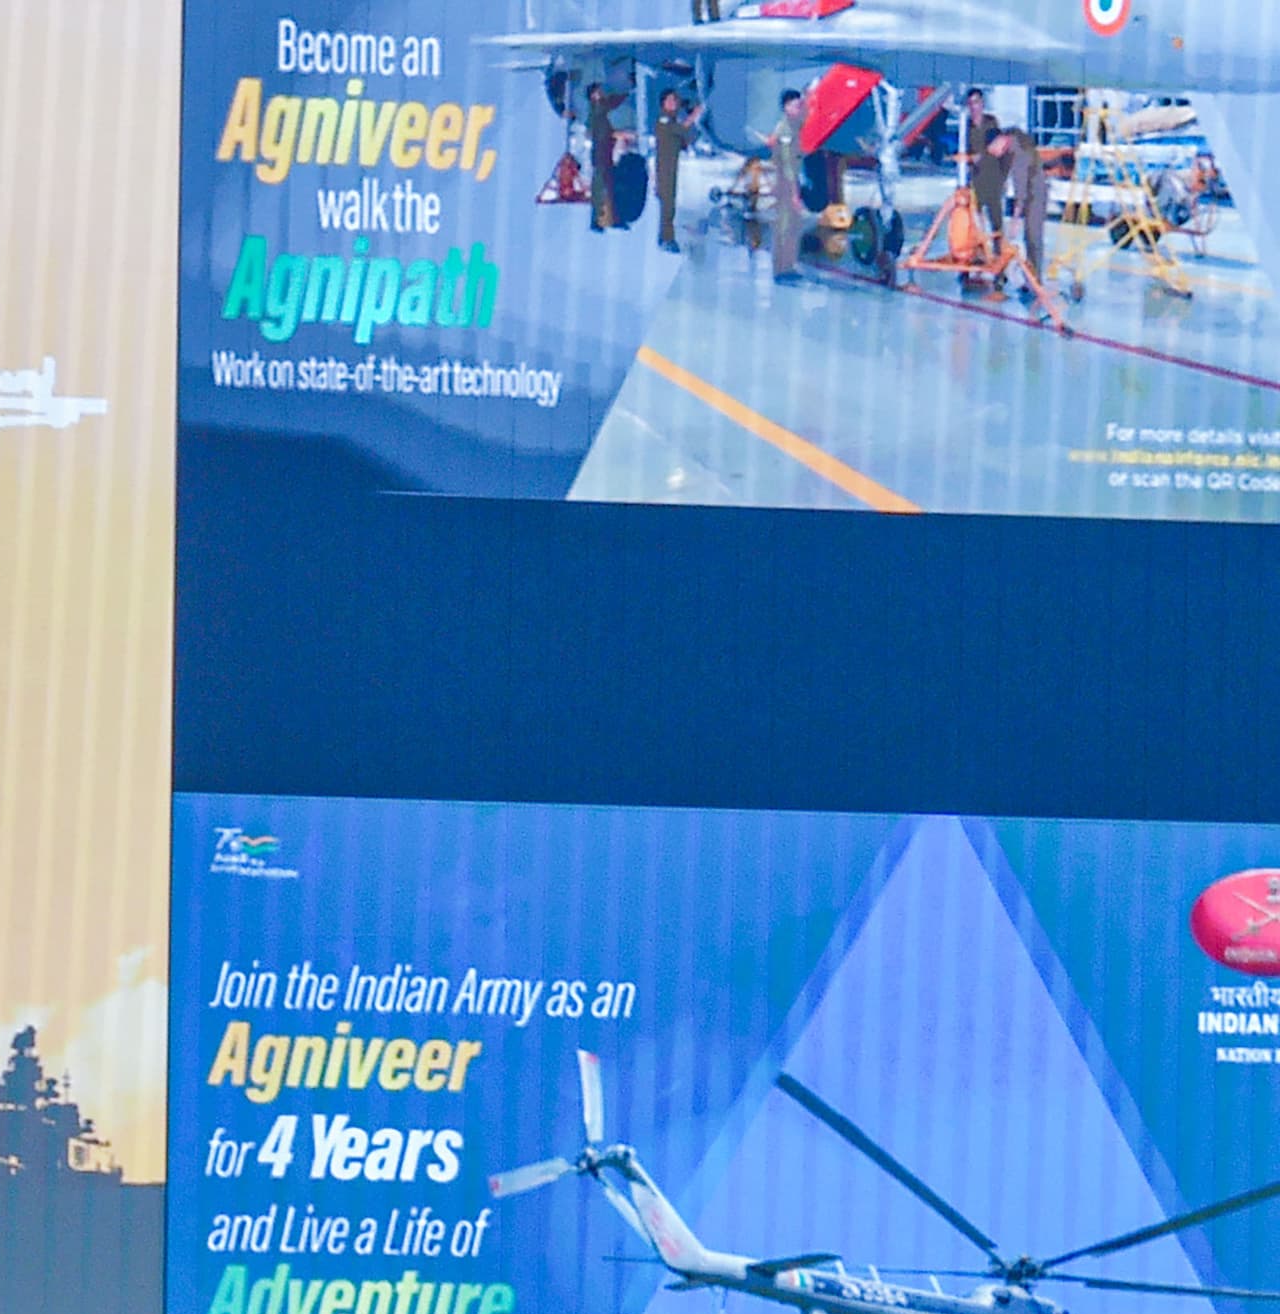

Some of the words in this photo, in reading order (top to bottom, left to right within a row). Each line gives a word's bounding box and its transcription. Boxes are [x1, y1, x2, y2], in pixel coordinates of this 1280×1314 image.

[277, 19, 396, 75] Become
[402, 37, 440, 77] an
[216, 77, 498, 184] Agniveer,
[318, 178, 389, 232] walk
[391, 183, 440, 234] the
[221, 234, 501, 344] Agnipath
[212, 351, 265, 387] Work
[268, 359, 294, 388] on
[297, 353, 451, 394] state-of-the-art
[452, 361, 561, 407] technology
[209, 961, 277, 1008] Join
[285, 961, 339, 1012] the
[344, 964, 450, 1014] Indian
[453, 968, 544, 1027] Army
[546, 980, 587, 1018] as
[592, 983, 636, 1020] an
[1197, 1012, 1279, 1035] INDIAN
[208, 1021, 483, 1103] Agniveer
[205, 1127, 256, 1178] for
[258, 1115, 299, 1179] 4
[310, 1114, 464, 1183] Years
[207, 1205, 278, 1253] and
[281, 1205, 350, 1255] Live
[354, 1222, 376, 1255] a
[385, 1208, 447, 1256] Life
[450, 1209, 492, 1258] of
